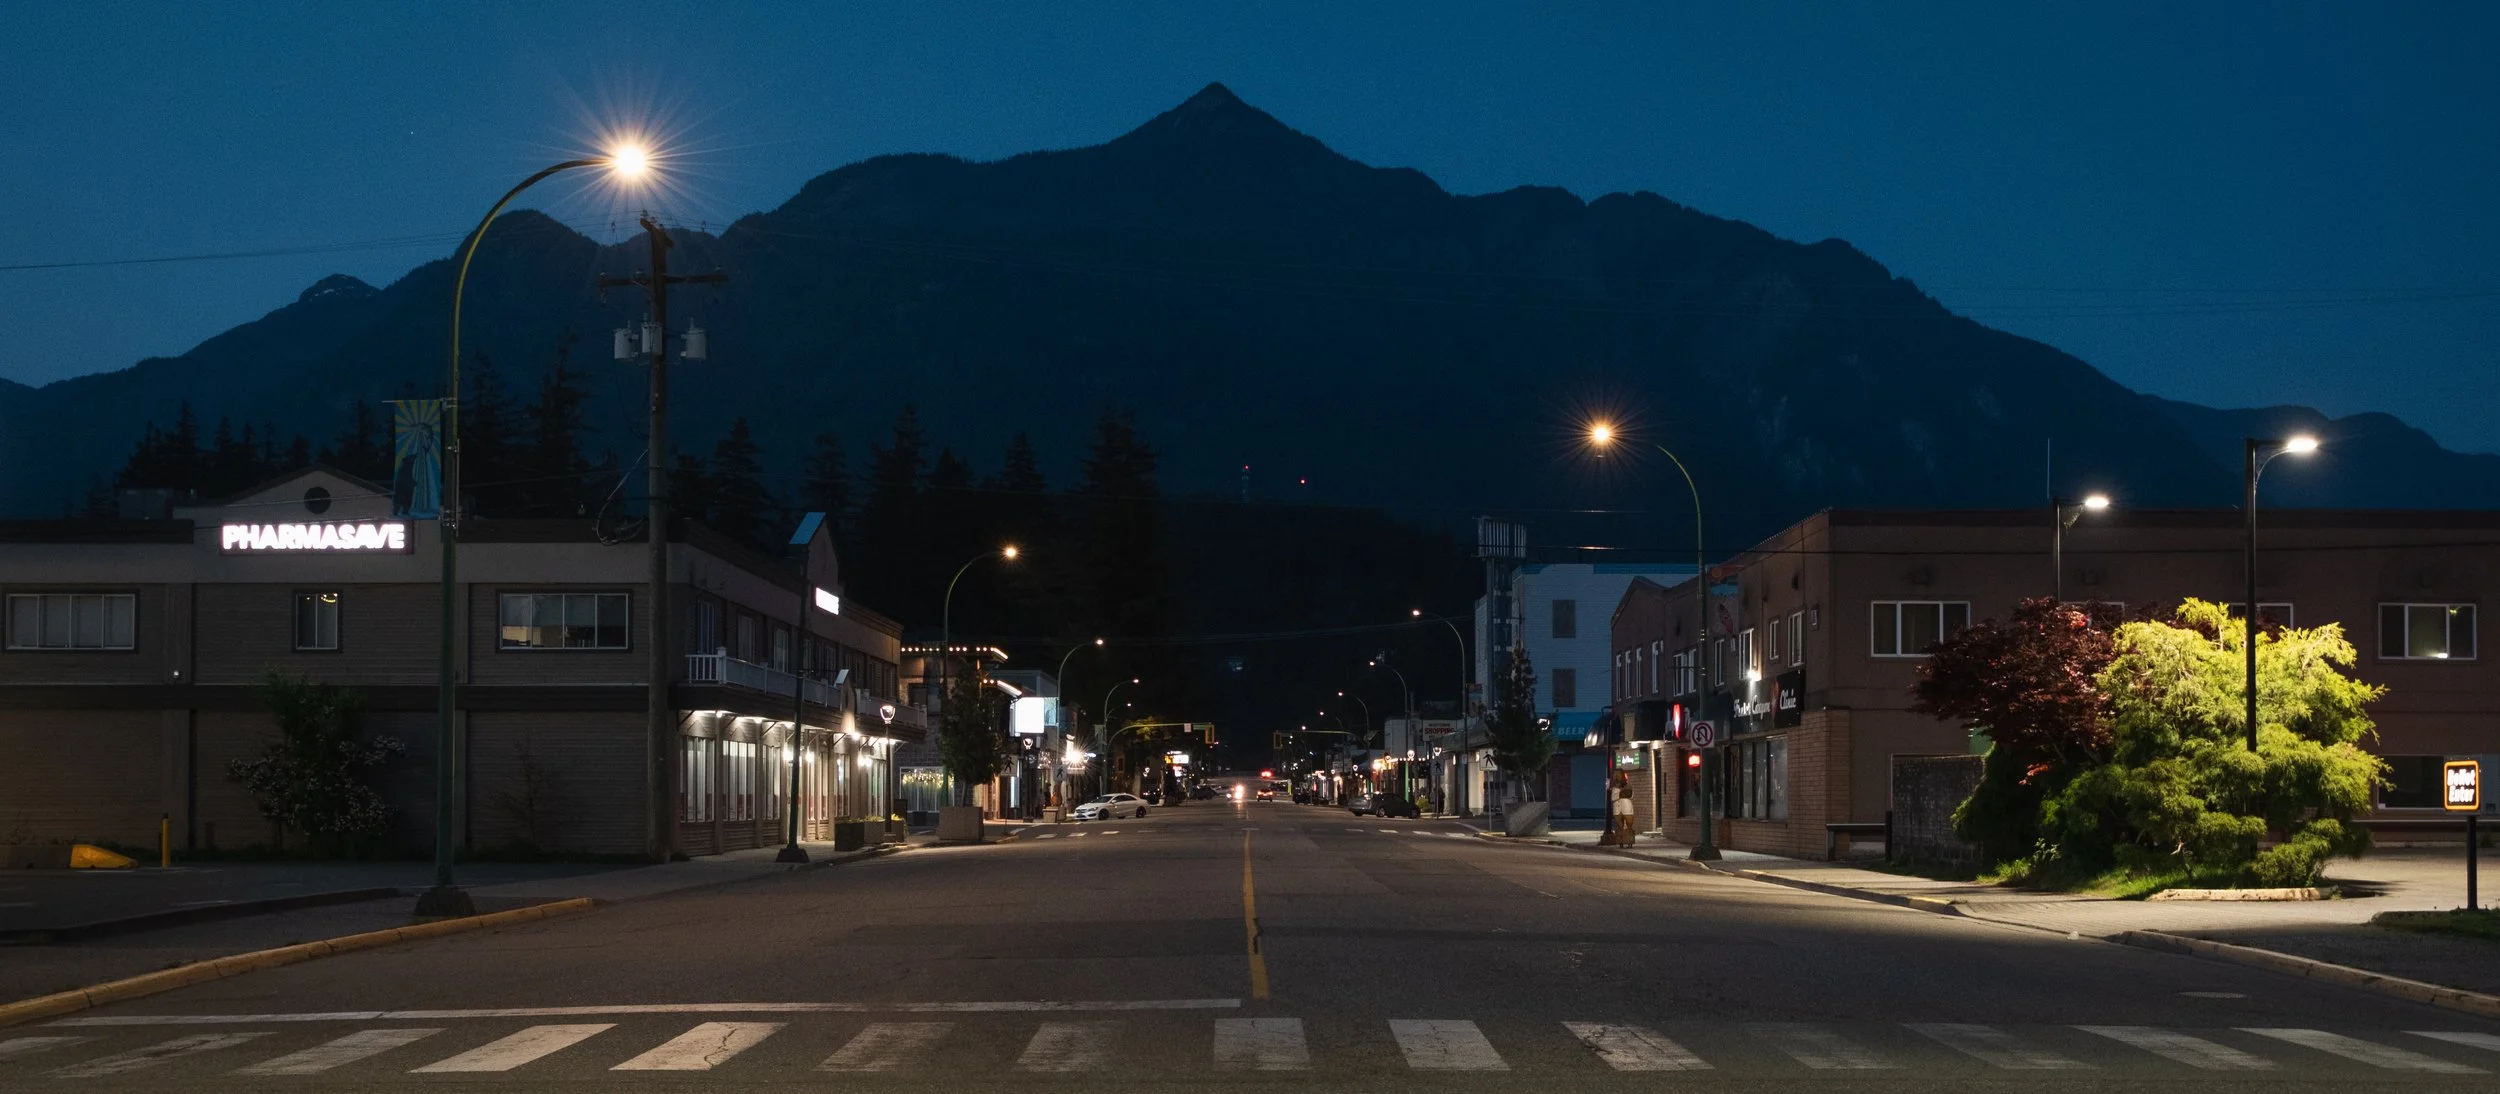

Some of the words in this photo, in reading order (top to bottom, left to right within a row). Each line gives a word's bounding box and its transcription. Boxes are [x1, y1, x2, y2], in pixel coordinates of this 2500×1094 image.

[222, 523, 405, 550] PHARMASAVE
[1557, 726, 1586, 736] BEER
[2449, 785, 2475, 802] Enter
